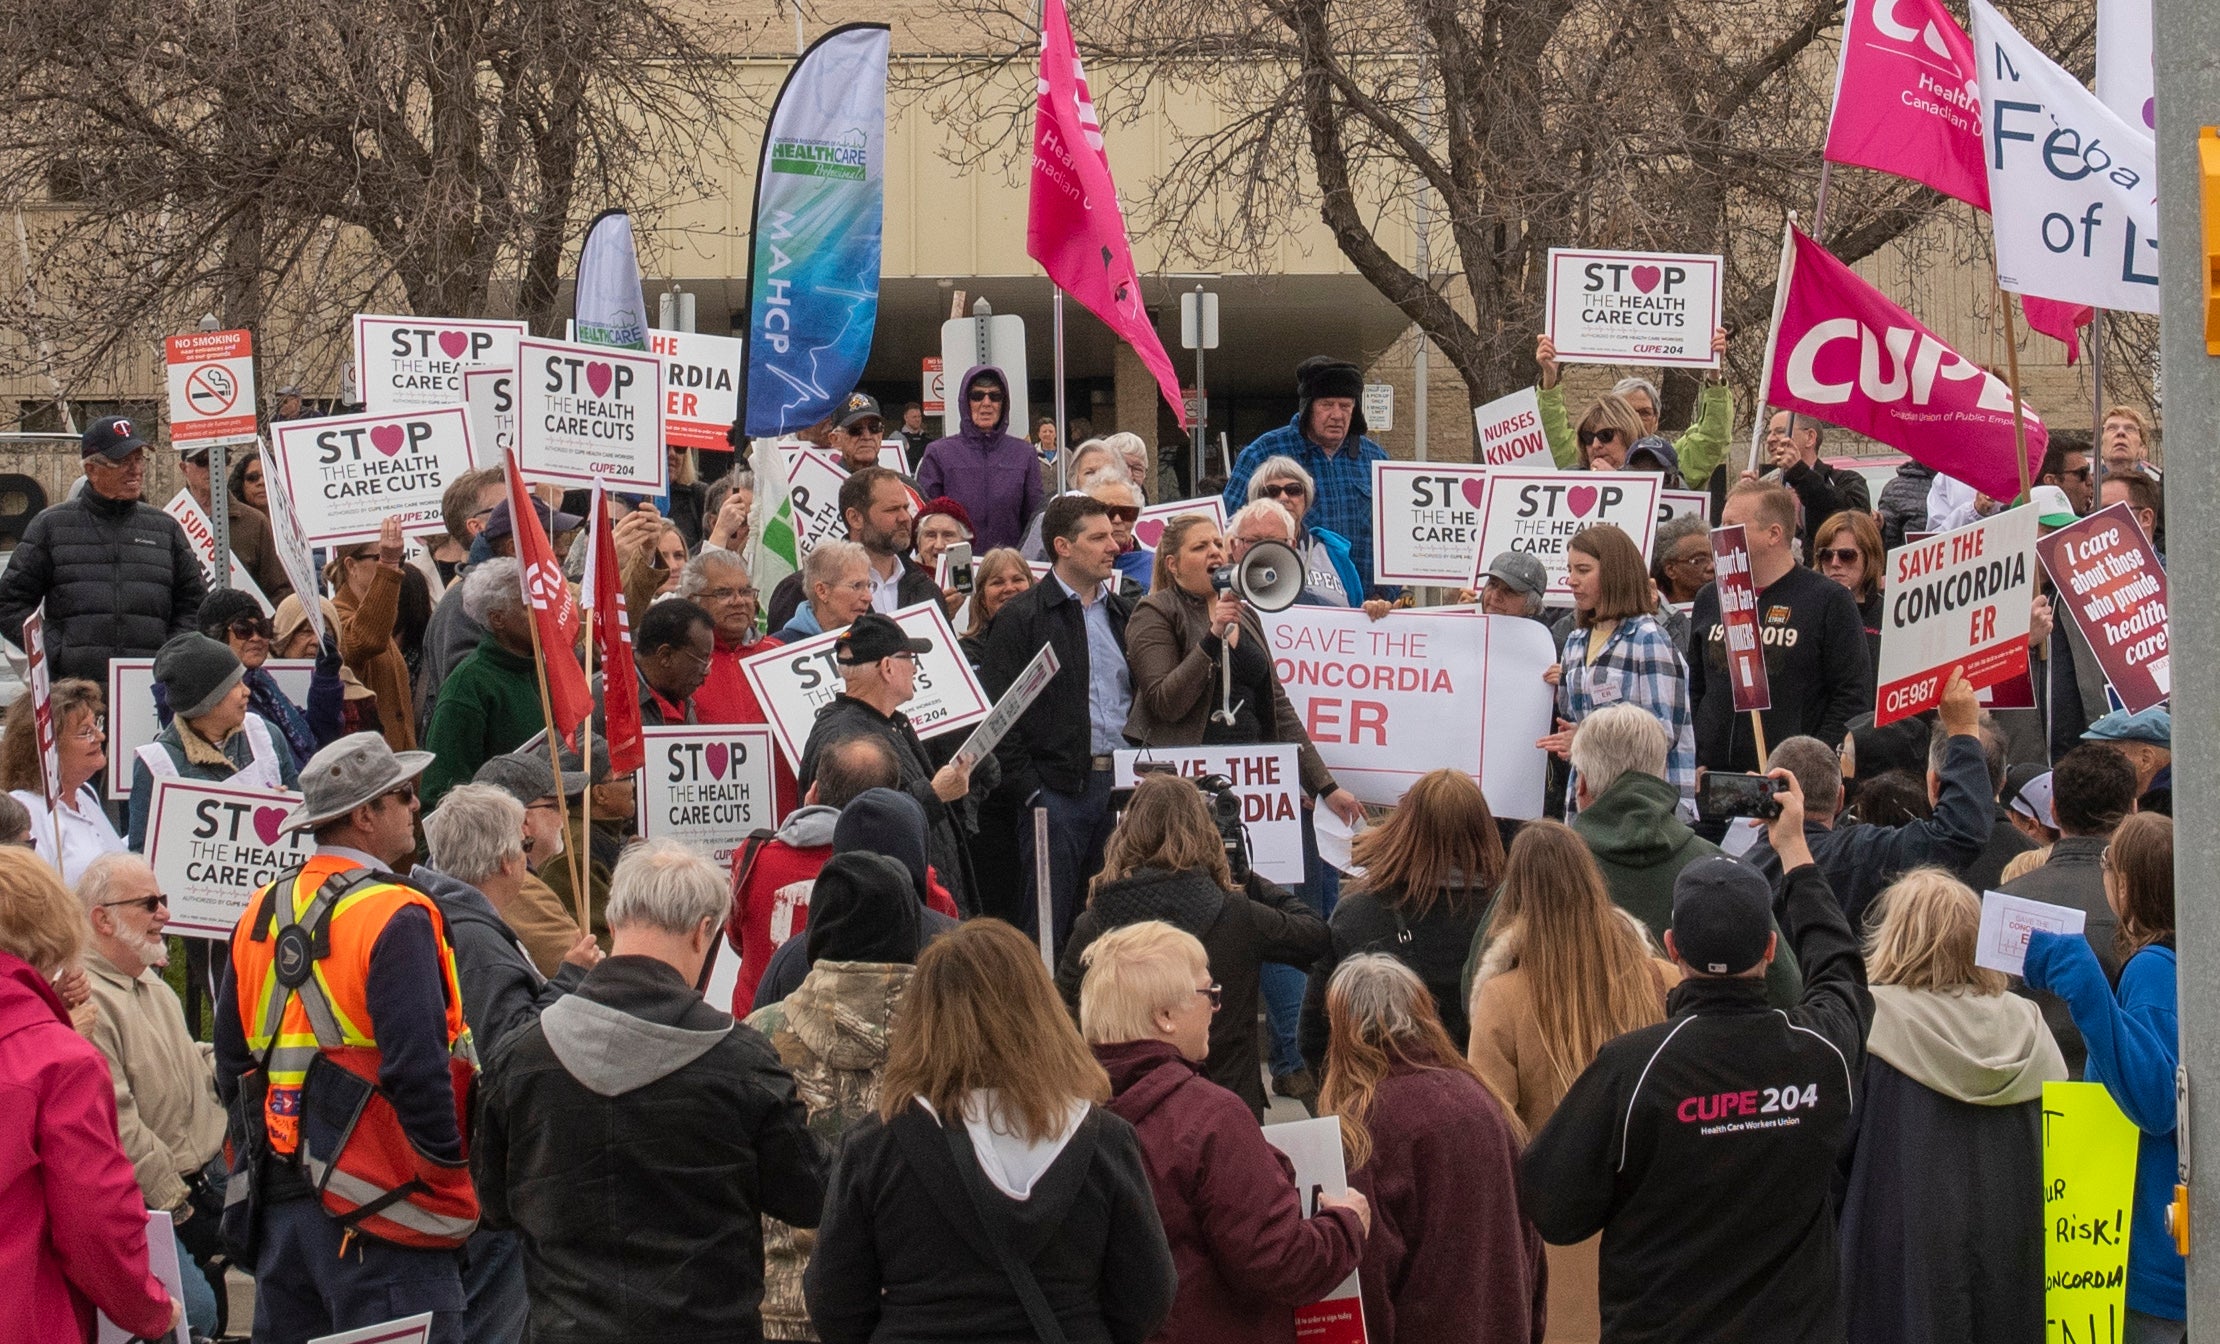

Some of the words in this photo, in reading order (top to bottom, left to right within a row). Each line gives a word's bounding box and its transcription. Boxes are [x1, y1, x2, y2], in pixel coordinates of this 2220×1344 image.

[1902, 90, 1968, 131] Canadian
[773, 143, 866, 165] HEALTHCARE
[1031, 154, 1080, 200] anadian
[2042, 202, 2103, 257] of
[763, 208, 794, 354] MAHCP
[1582, 293, 1613, 307] THE
[1620, 296, 1685, 310] HEALTH
[1582, 309, 1632, 324] CARE
[1637, 311, 1685, 327] CUTS
[175, 339, 190, 348] NO
[192, 333, 241, 347] SMOKING
[649, 334, 678, 356] HE
[1633, 344, 1662, 354] CUPE
[1663, 346, 1684, 354] 204
[391, 358, 423, 373] THE
[392, 374, 443, 390] CARE
[545, 394, 572, 414] THE
[577, 399, 634, 421] HEALTH
[666, 391, 698, 417] ER
[1955, 411, 1985, 422] Public
[544, 415, 588, 436] CARE
[592, 420, 634, 442] CUTS
[1483, 411, 1535, 443] NURSES
[1486, 430, 1545, 467] KNOW
[319, 463, 358, 481] THE
[363, 454, 440, 477] HEALTH
[589, 461, 615, 474] CUPE
[616, 463, 634, 476] 204
[323, 478, 383, 500] CARE
[386, 471, 442, 492] CUTS
[173, 500, 186, 513] I
[1411, 508, 1452, 525] THE
[801, 502, 837, 555] EALTH
[1412, 526, 1466, 543] CARE
[1514, 519, 1546, 535] THE
[1510, 537, 1562, 554] CARE
[1898, 541, 1945, 584] SAVE
[1952, 527, 1985, 565] THE
[2065, 542, 2078, 566] I
[2080, 525, 2121, 561] care
[1735, 546, 1748, 574] Our
[2069, 565, 2107, 596] about
[2104, 548, 2145, 579] those
[1893, 551, 2026, 628] CONCORDIA
[2082, 595, 2116, 622] who
[2115, 572, 2161, 610] provide
[1969, 604, 1997, 647] ER
[2103, 599, 2168, 646] health
[1274, 623, 1356, 655] SAVE
[1366, 631, 1428, 659] THE
[1275, 657, 1454, 694] ONCORDIA
[1886, 676, 1938, 713] OE987
[924, 707, 948, 723] 204
[1306, 696, 1389, 746] ER
[1225, 756, 1280, 786] THE
[668, 785, 694, 803] THE
[698, 783, 750, 802] HEALTH
[669, 805, 711, 826] CARE
[713, 803, 750, 824] CUTS
[190, 840, 229, 862] THE
[186, 862, 249, 887] CARE
[1677, 1090, 1759, 1123] CUPE
[1760, 1083, 1818, 1113] 204
[1701, 1125, 1727, 1136] Health
[1727, 1123, 1745, 1132] Care
[1745, 1120, 1777, 1130] Workers
[1778, 1116, 1800, 1126] Union
[2046, 1265, 2124, 1293] ONCORDIA
